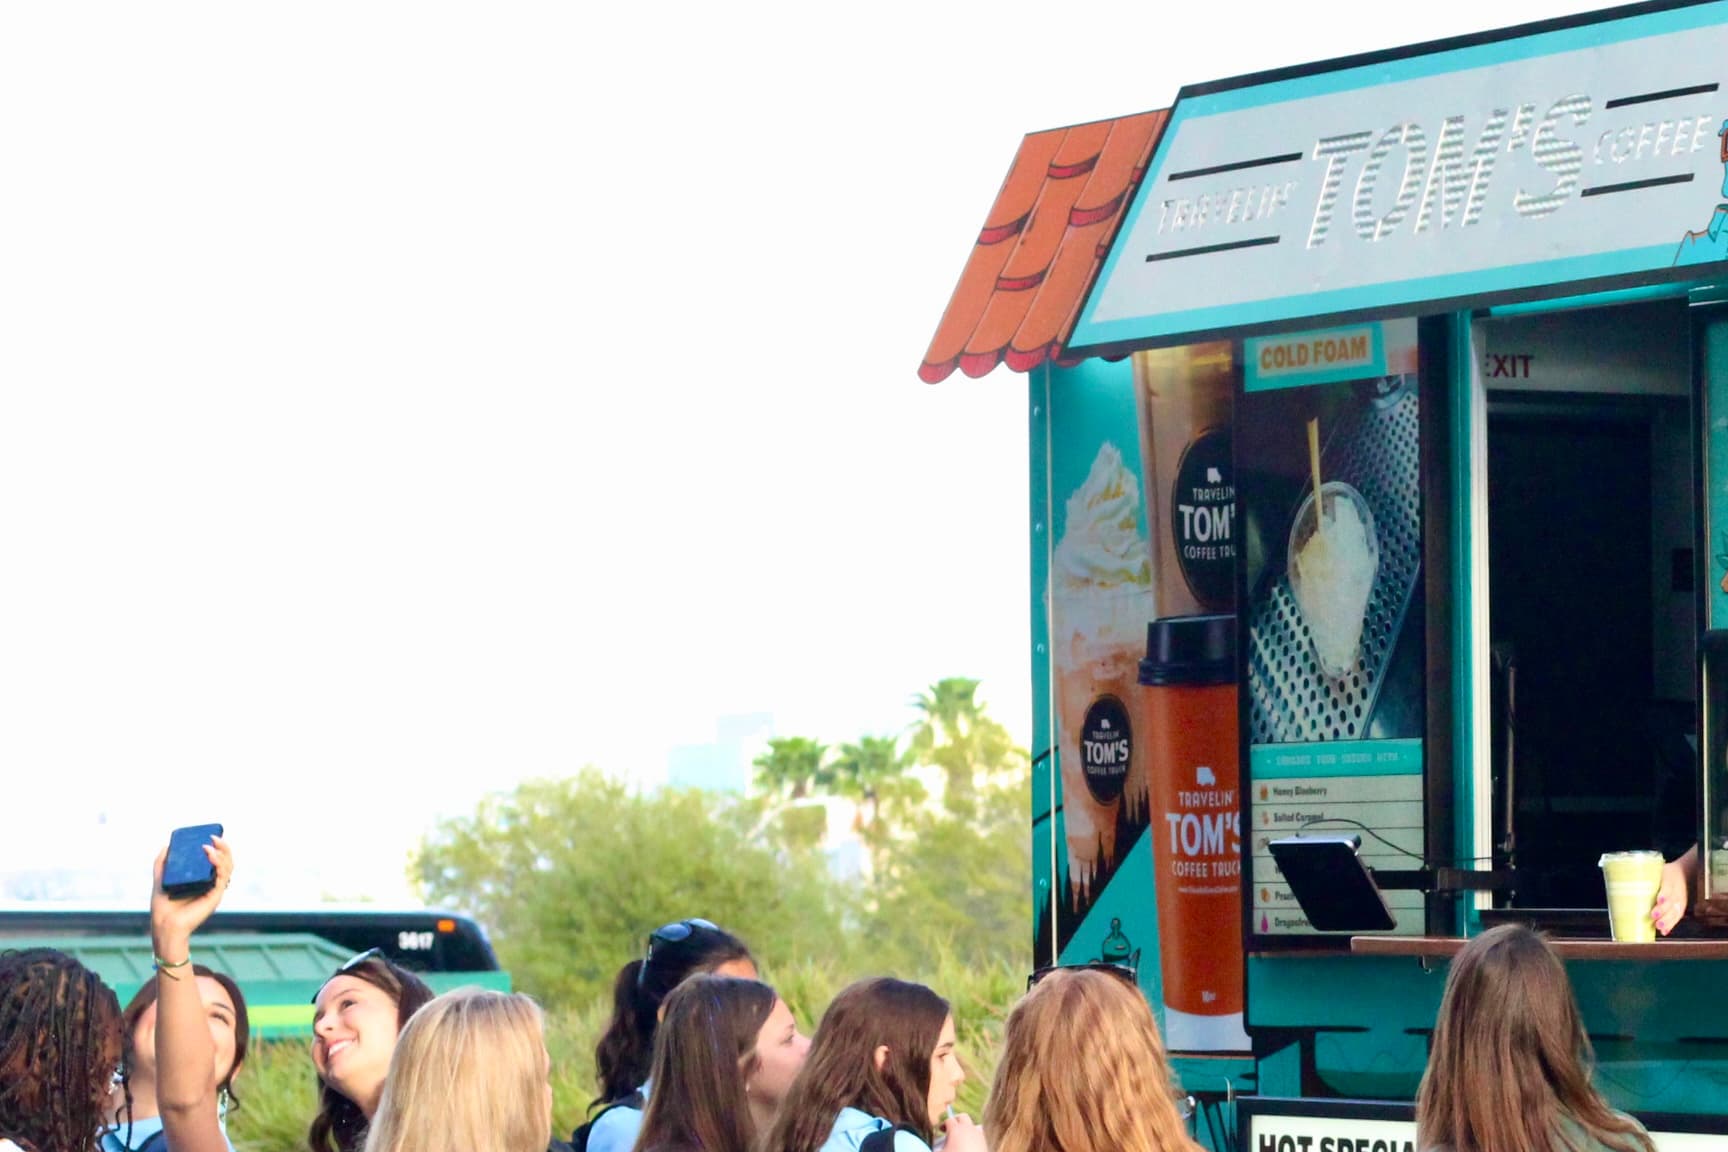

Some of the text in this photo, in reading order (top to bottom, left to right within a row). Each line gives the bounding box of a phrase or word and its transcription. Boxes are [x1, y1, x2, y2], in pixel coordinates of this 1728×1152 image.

[1306, 93, 1592, 250] TOM'S
[1594, 115, 1713, 165] COFFEE
[1261, 335, 1367, 370] COLD FOAM
[1192, 485, 1236, 501] TRAVELIN
[1179, 502, 1236, 542] TOM'
[1184, 544, 1236, 560] COFFEE TRU
[1084, 739, 1129, 764] TOM'S
[1171, 861, 1208, 877] COFFEE
